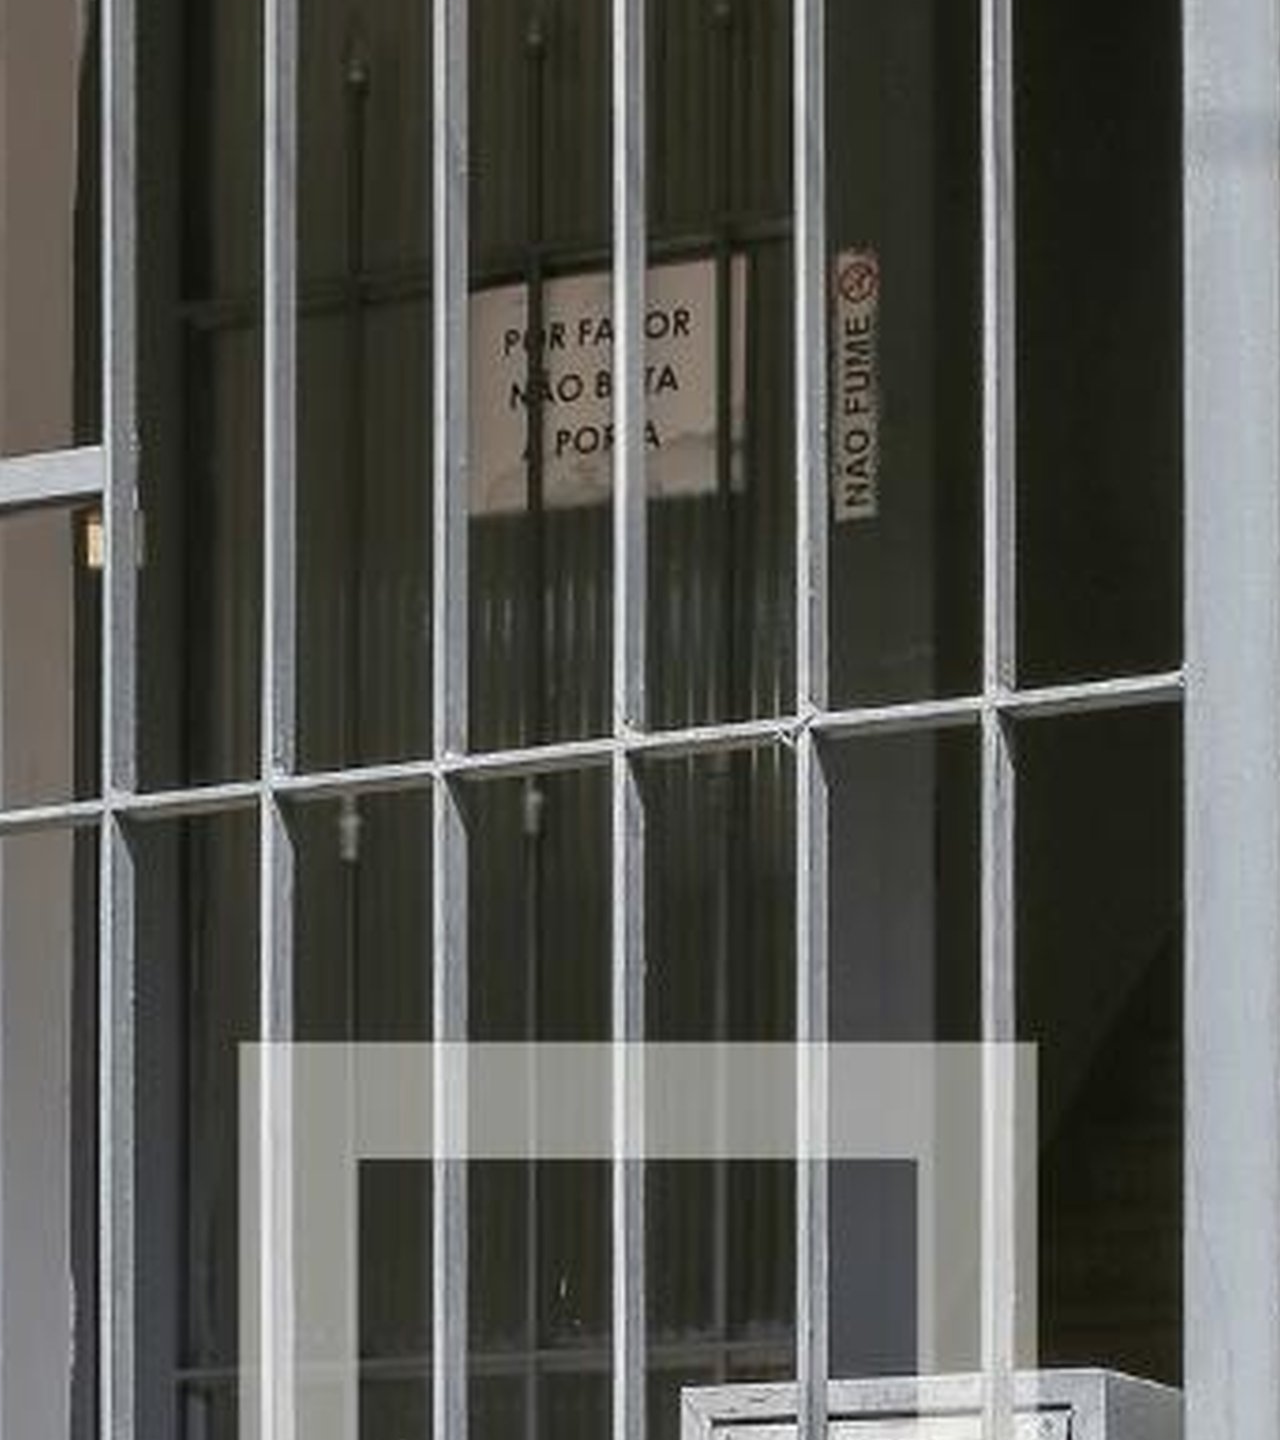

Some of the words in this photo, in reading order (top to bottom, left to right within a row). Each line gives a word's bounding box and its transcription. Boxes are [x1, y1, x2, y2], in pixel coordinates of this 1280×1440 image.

[577, 308, 690, 348] FAOR
[594, 364, 679, 401] BTA
[844, 314, 870, 416] FUME
[555, 419, 661, 459] PORA
